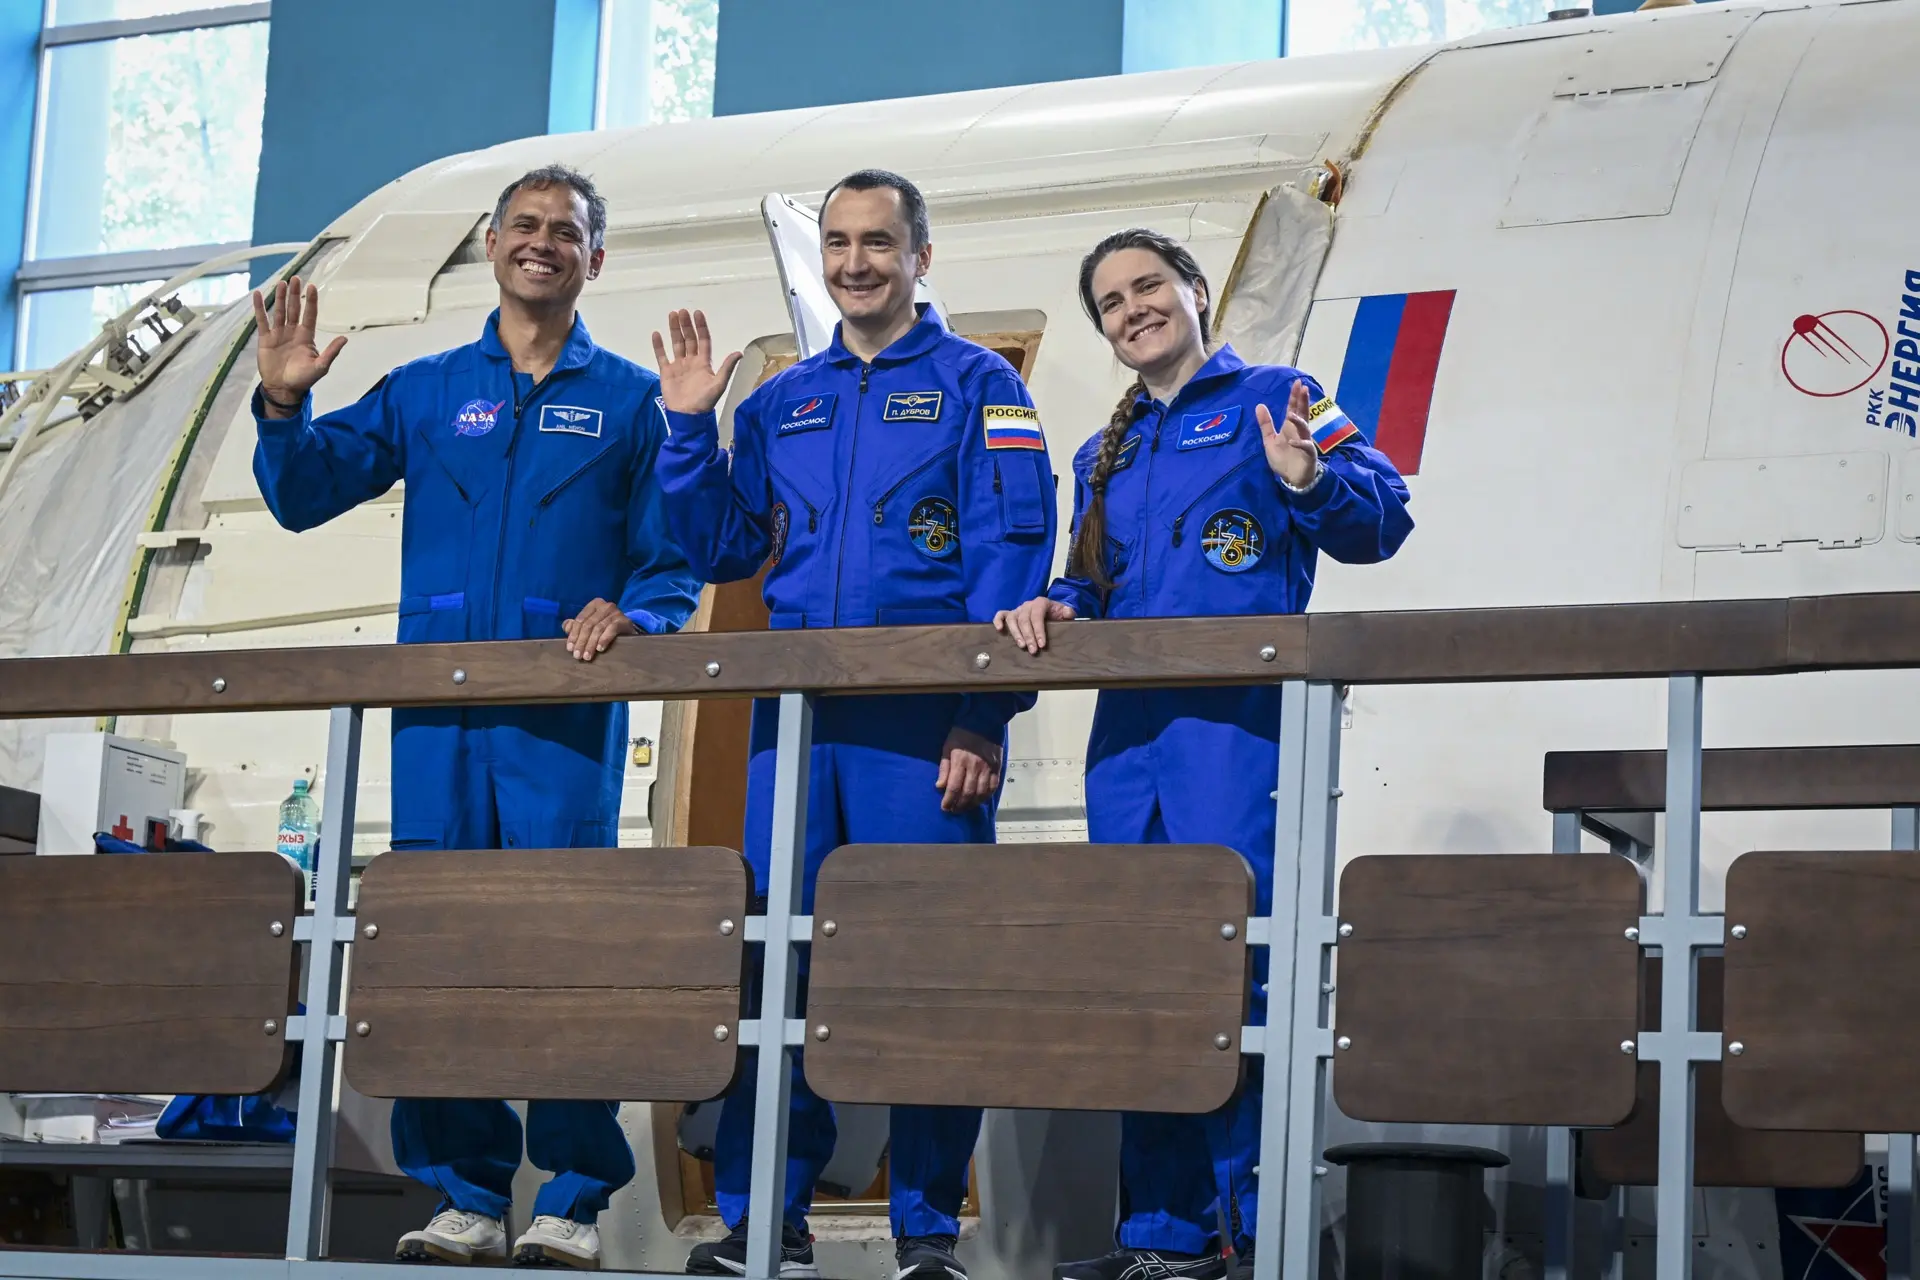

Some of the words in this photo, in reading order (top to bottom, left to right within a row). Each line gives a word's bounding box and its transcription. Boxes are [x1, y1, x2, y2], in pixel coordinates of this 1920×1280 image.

[1884, 269, 1920, 438] ЭНЕРГИЯ
[900, 408, 931, 416] ДУБРОВ
[986, 408, 1038, 421] РОССИЯ
[1308, 399, 1335, 421] ОССИЯ
[1866, 388, 1884, 426] РКК
[459, 412, 495, 423] NASA
[780, 417, 827, 431] РОСКОСМОС
[1181, 430, 1233, 446] РОСКОСМОС
[926, 519, 946, 551] 75
[1220, 532, 1246, 566] 75
[277, 834, 304, 844] РХЫЗ
